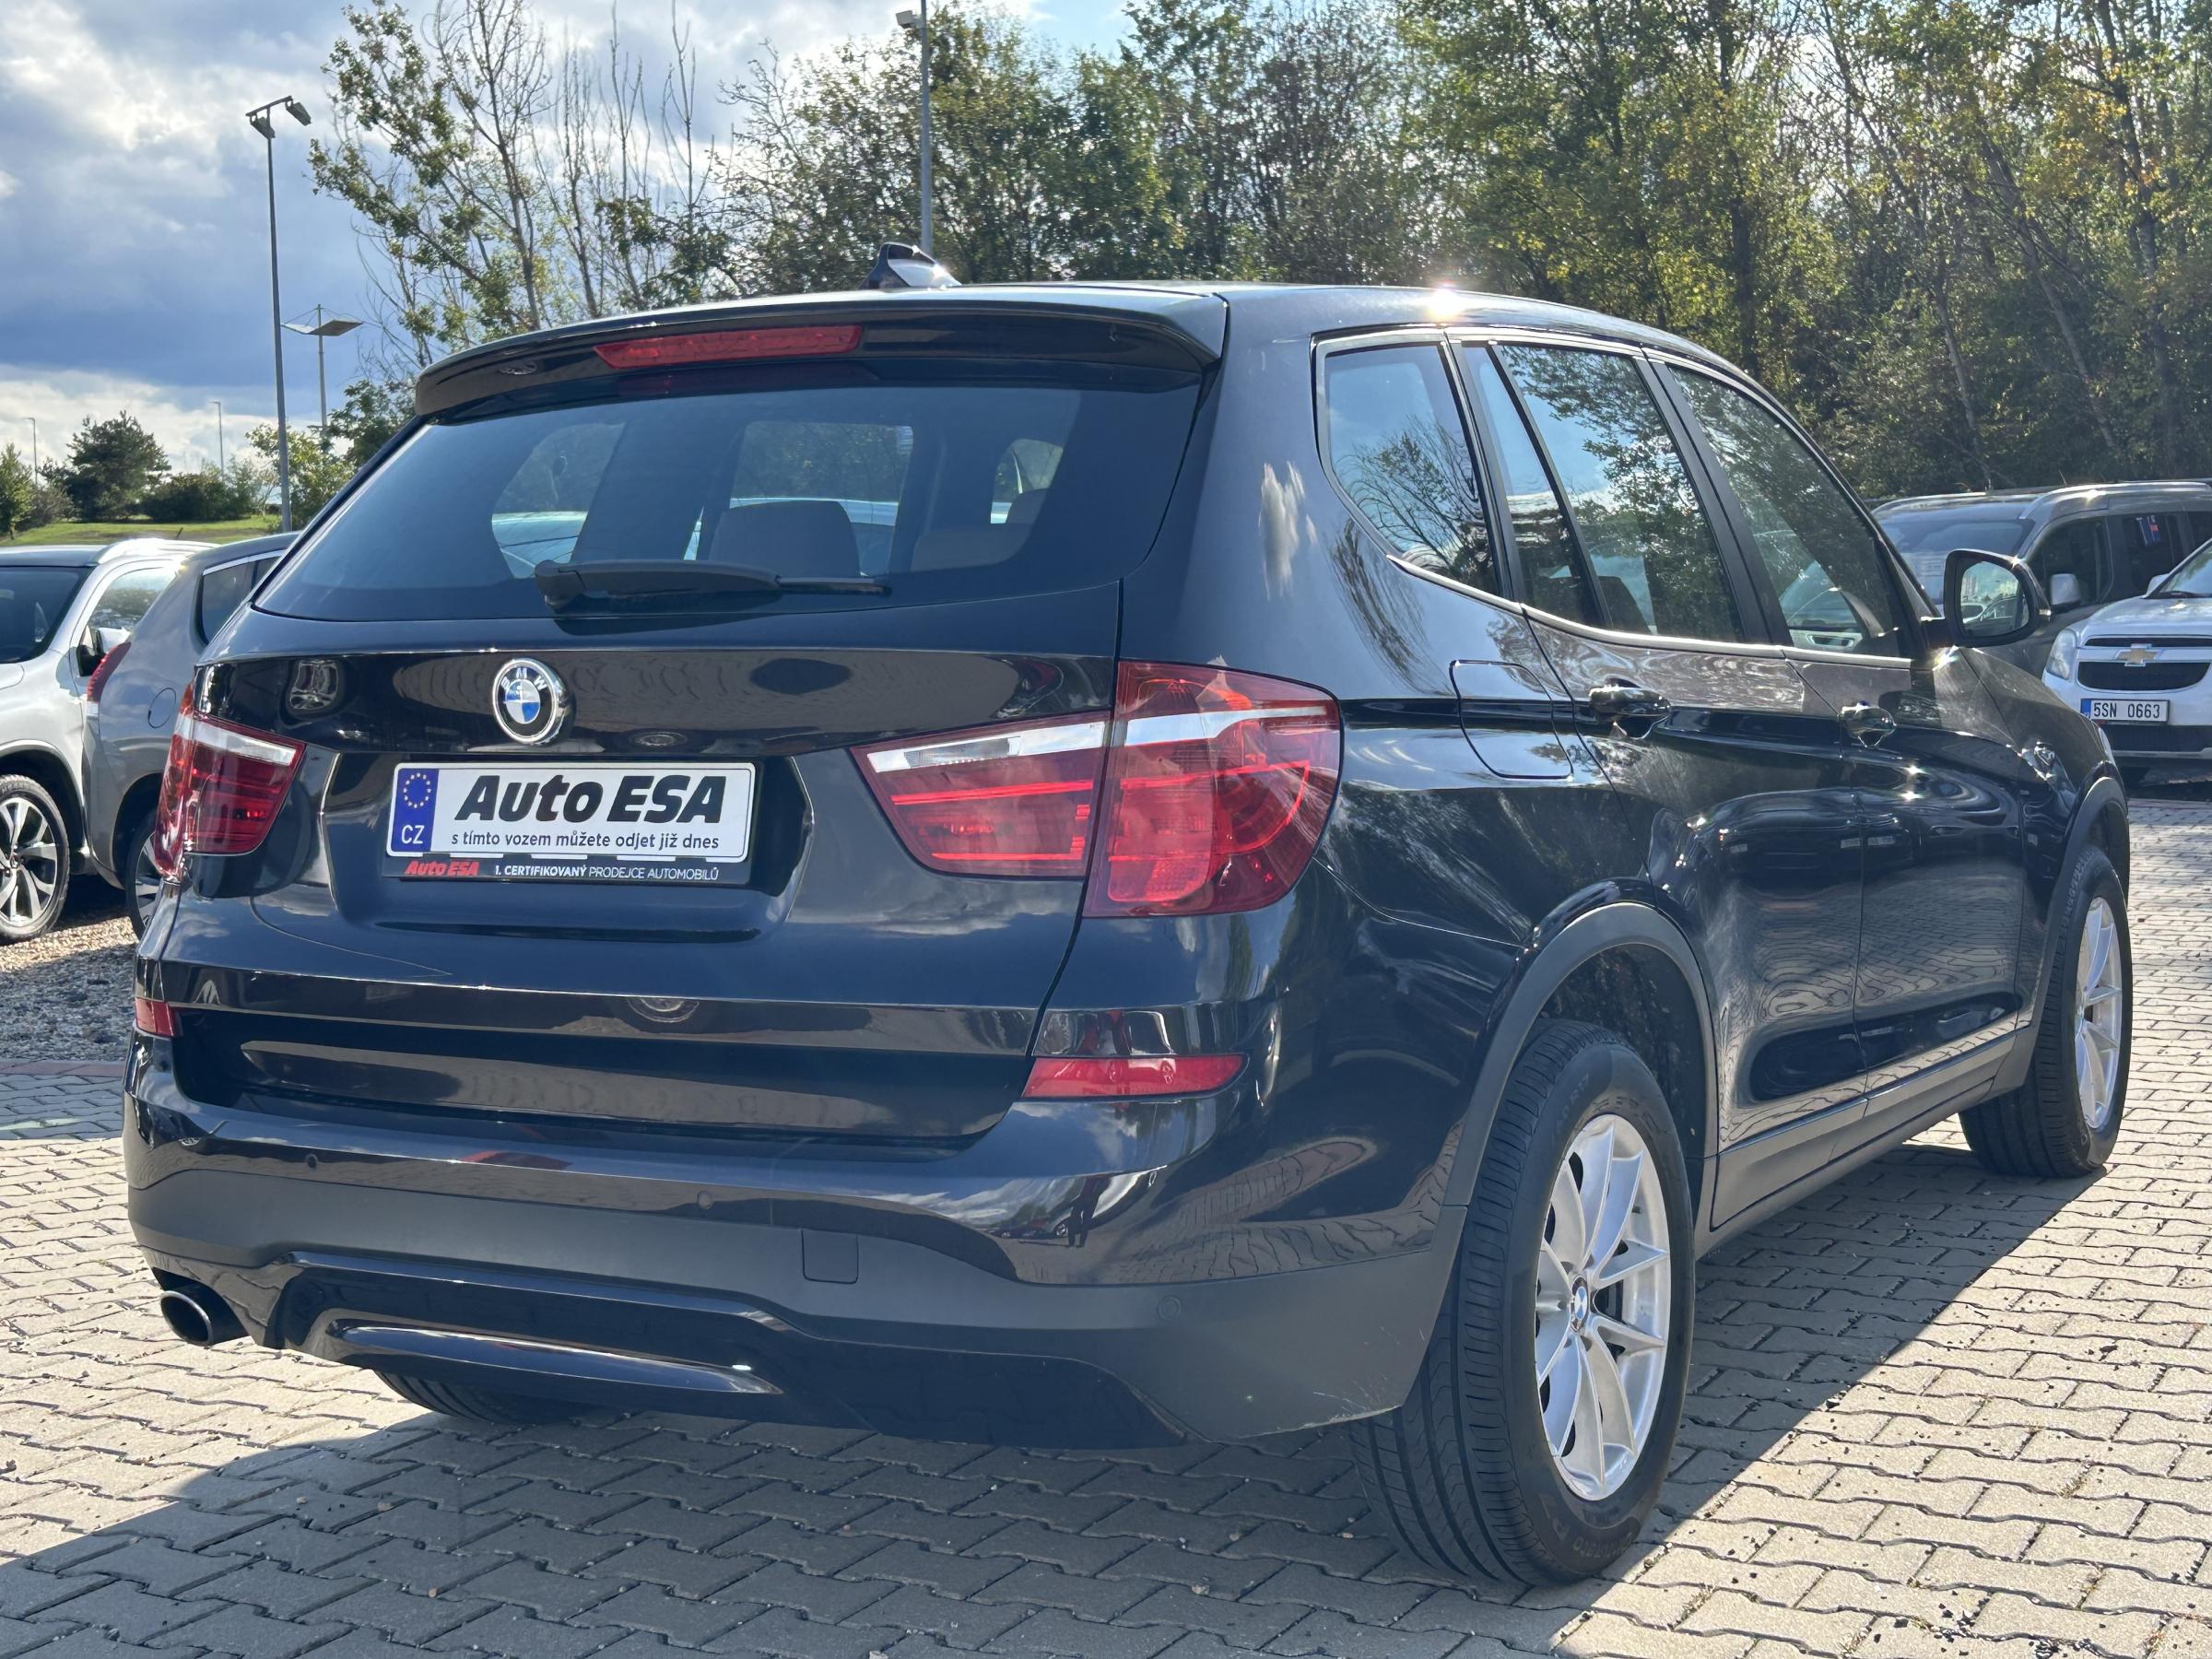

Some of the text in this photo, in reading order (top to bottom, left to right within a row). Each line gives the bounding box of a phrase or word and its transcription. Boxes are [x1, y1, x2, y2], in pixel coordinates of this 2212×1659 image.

[500, 667, 547, 691] BMW
[2093, 702, 2117, 718] 5SN
[2127, 703, 2160, 718] 0663
[454, 774, 727, 824] Auto ESA
[401, 824, 425, 844] CZ
[452, 830, 720, 851] s tímto vozem můžete odjet již dnes
[405, 860, 480, 877] Auto ESA
[504, 865, 587, 877] CERTIFIKOVANÝ
[588, 866, 645, 879] PRODEJCE
[647, 866, 720, 881] AUTOMOBILŮ
